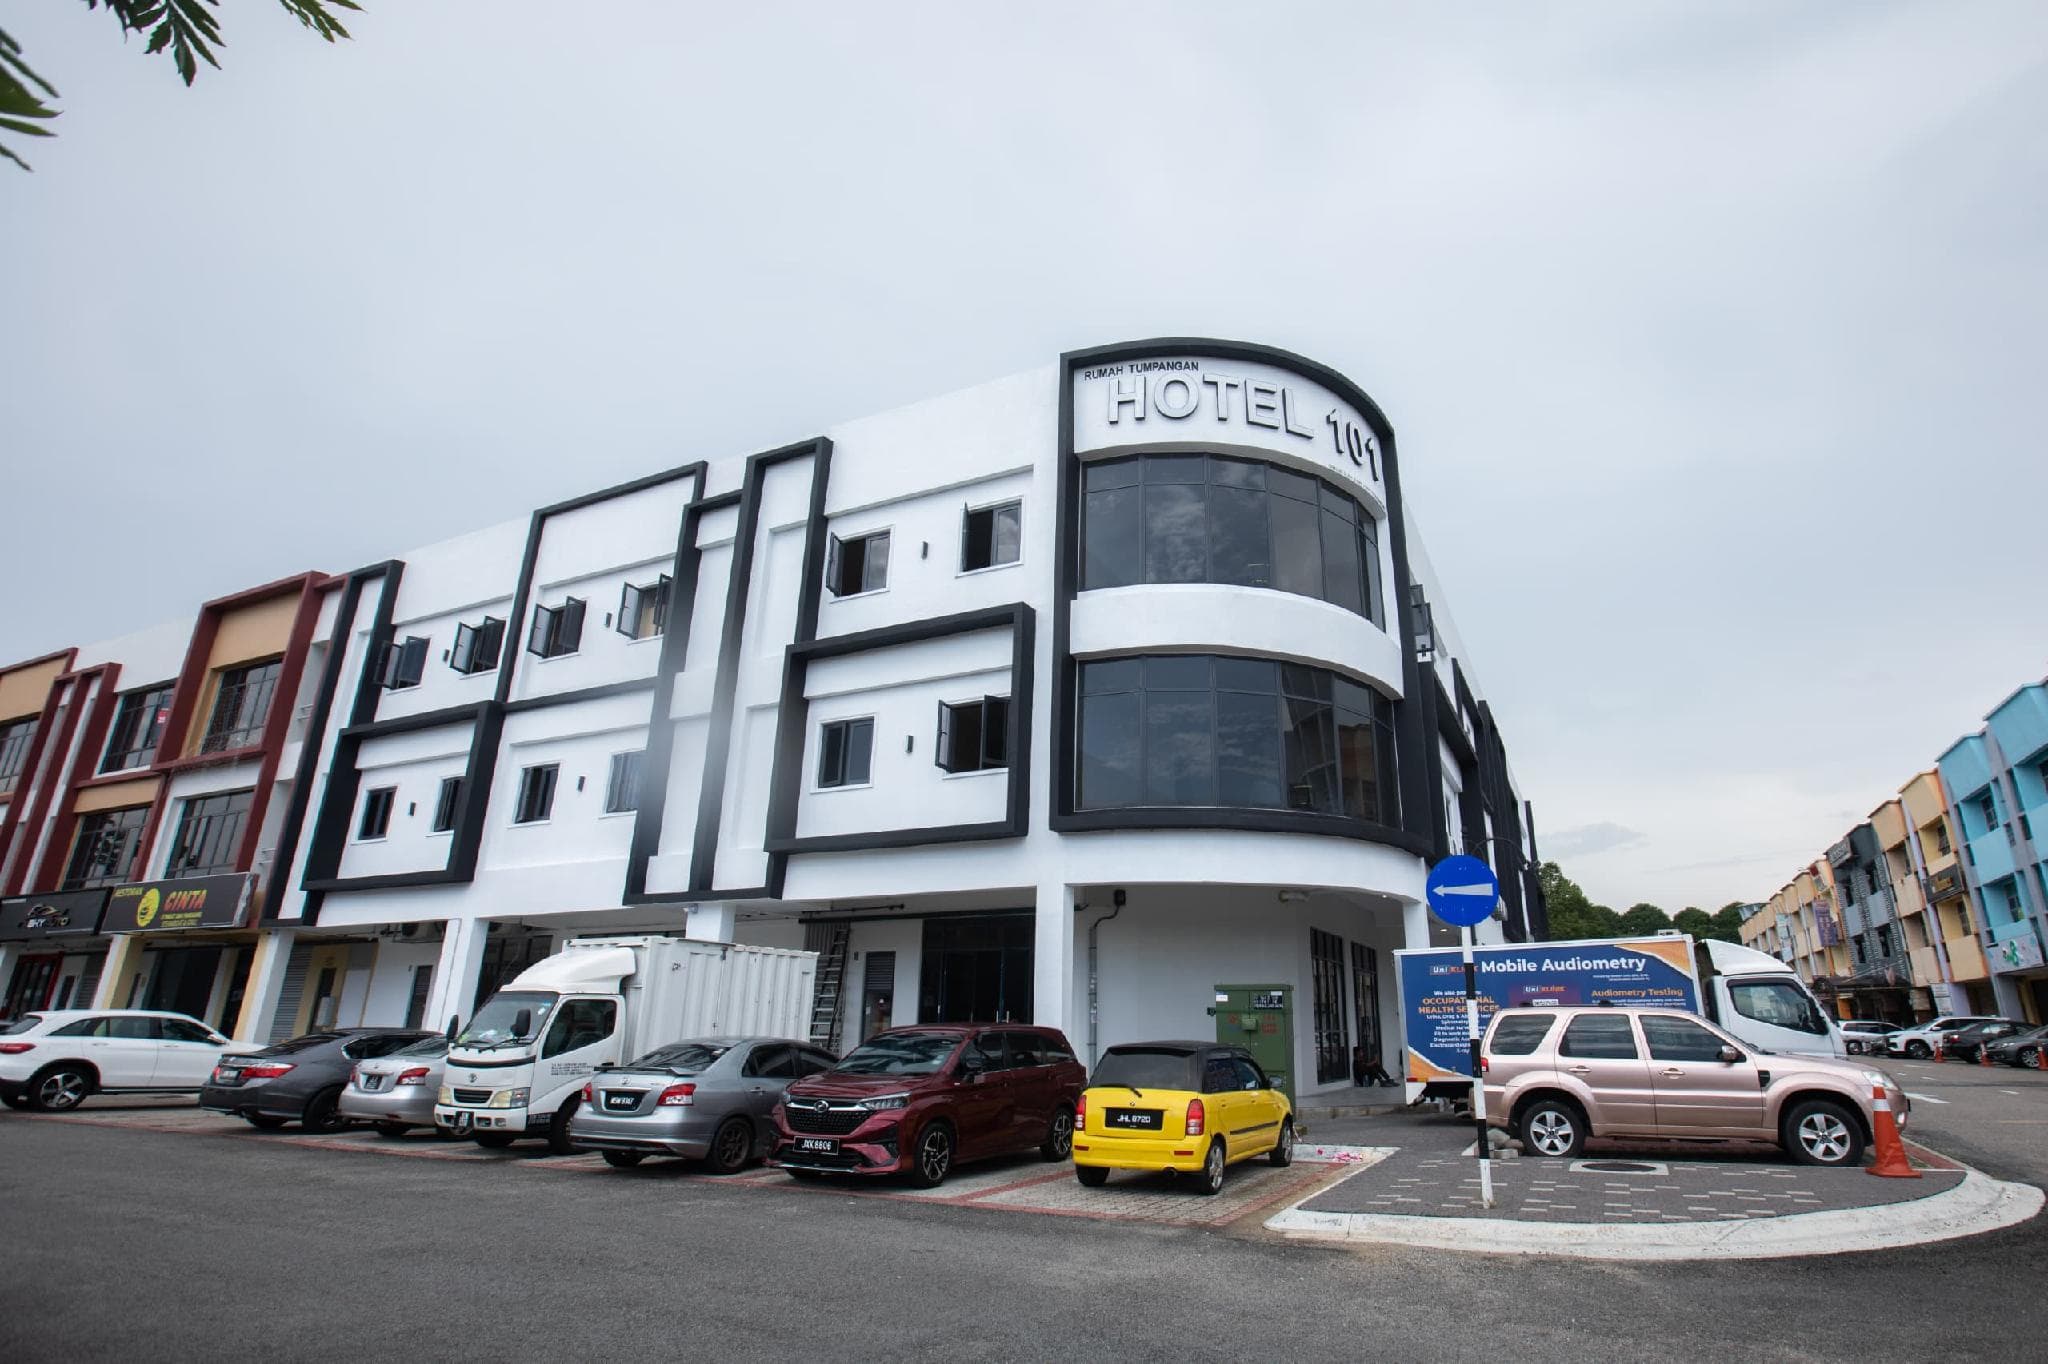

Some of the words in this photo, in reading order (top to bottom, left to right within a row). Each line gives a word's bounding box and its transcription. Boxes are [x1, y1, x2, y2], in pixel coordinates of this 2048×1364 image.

[1084, 366, 1124, 381] RUMAH
[1128, 361, 1199, 374] TUMPANGAN
[1108, 372, 1314, 439] HOTEL
[1326, 408, 1379, 482] 101
[163, 889, 207, 912] CINTA
[1481, 958, 1537, 973] Mobile
[1542, 957, 1646, 972] Audiometry
[1592, 988, 1646, 997] Audiometry
[1648, 987, 1683, 997] Testing
[1423, 996, 1495, 1005] OCCUPATNAL
[1418, 1006, 1454, 1014] HEALTH
